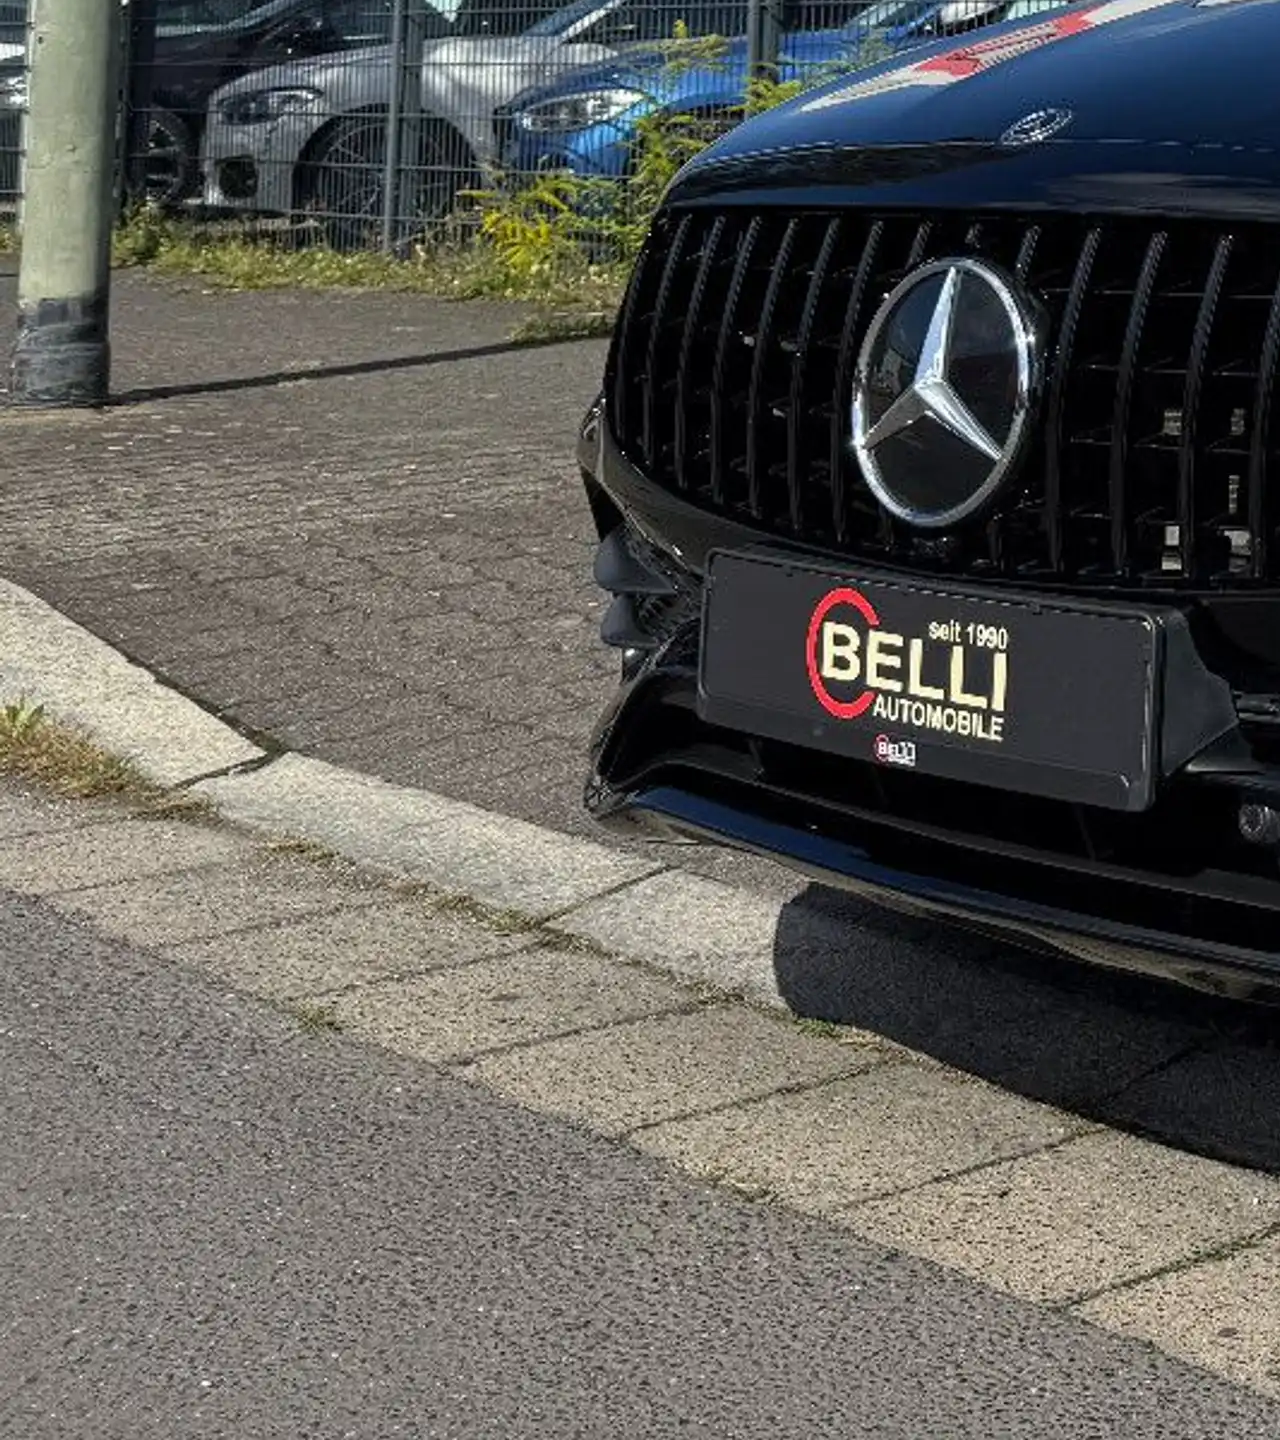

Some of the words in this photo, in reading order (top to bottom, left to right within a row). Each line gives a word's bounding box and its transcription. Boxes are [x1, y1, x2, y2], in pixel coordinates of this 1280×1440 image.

[928, 619, 962, 644] seit
[966, 621, 1009, 651] 1990
[820, 621, 1008, 712] BELLI
[872, 692, 1004, 742] AUTOMOBILE
